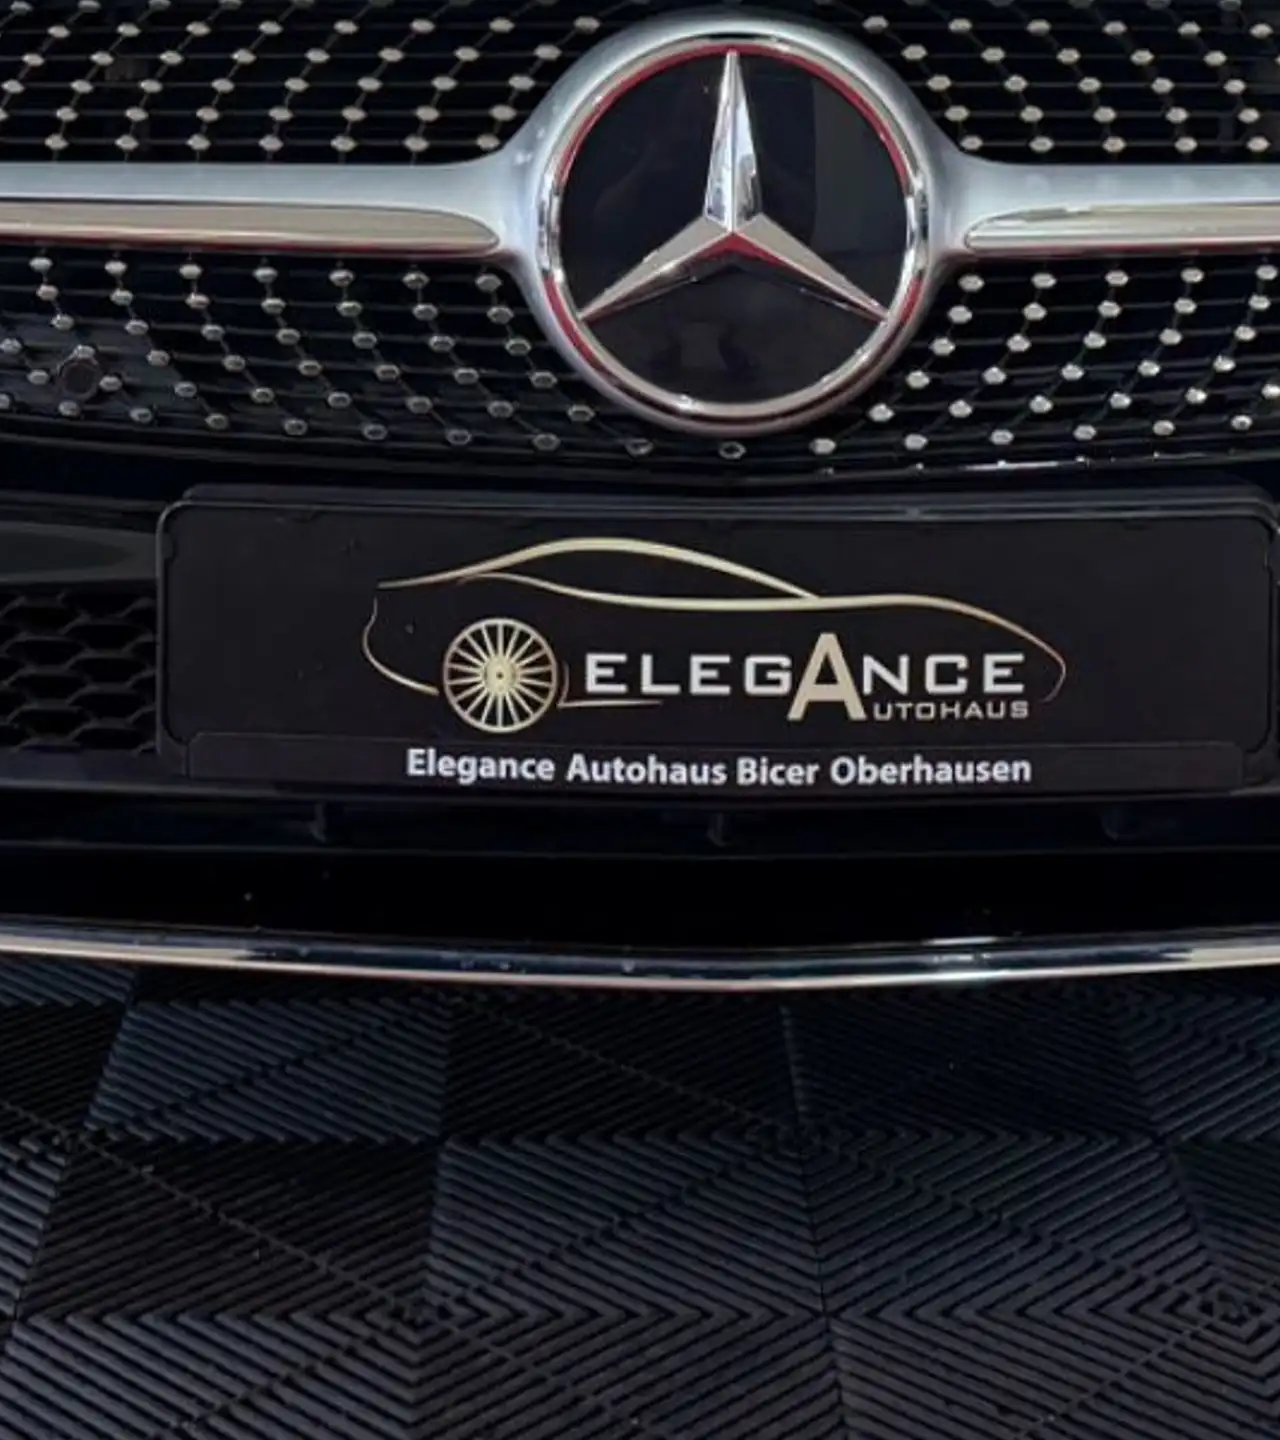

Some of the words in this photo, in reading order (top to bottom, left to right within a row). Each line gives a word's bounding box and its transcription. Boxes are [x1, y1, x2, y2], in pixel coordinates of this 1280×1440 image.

[585, 632, 1026, 722] ELEGANCE
[406, 747, 556, 785] Elegance
[566, 753, 728, 785] Autohaus
[736, 756, 819, 786] Bicer
[830, 753, 1032, 786] Oberhausen
